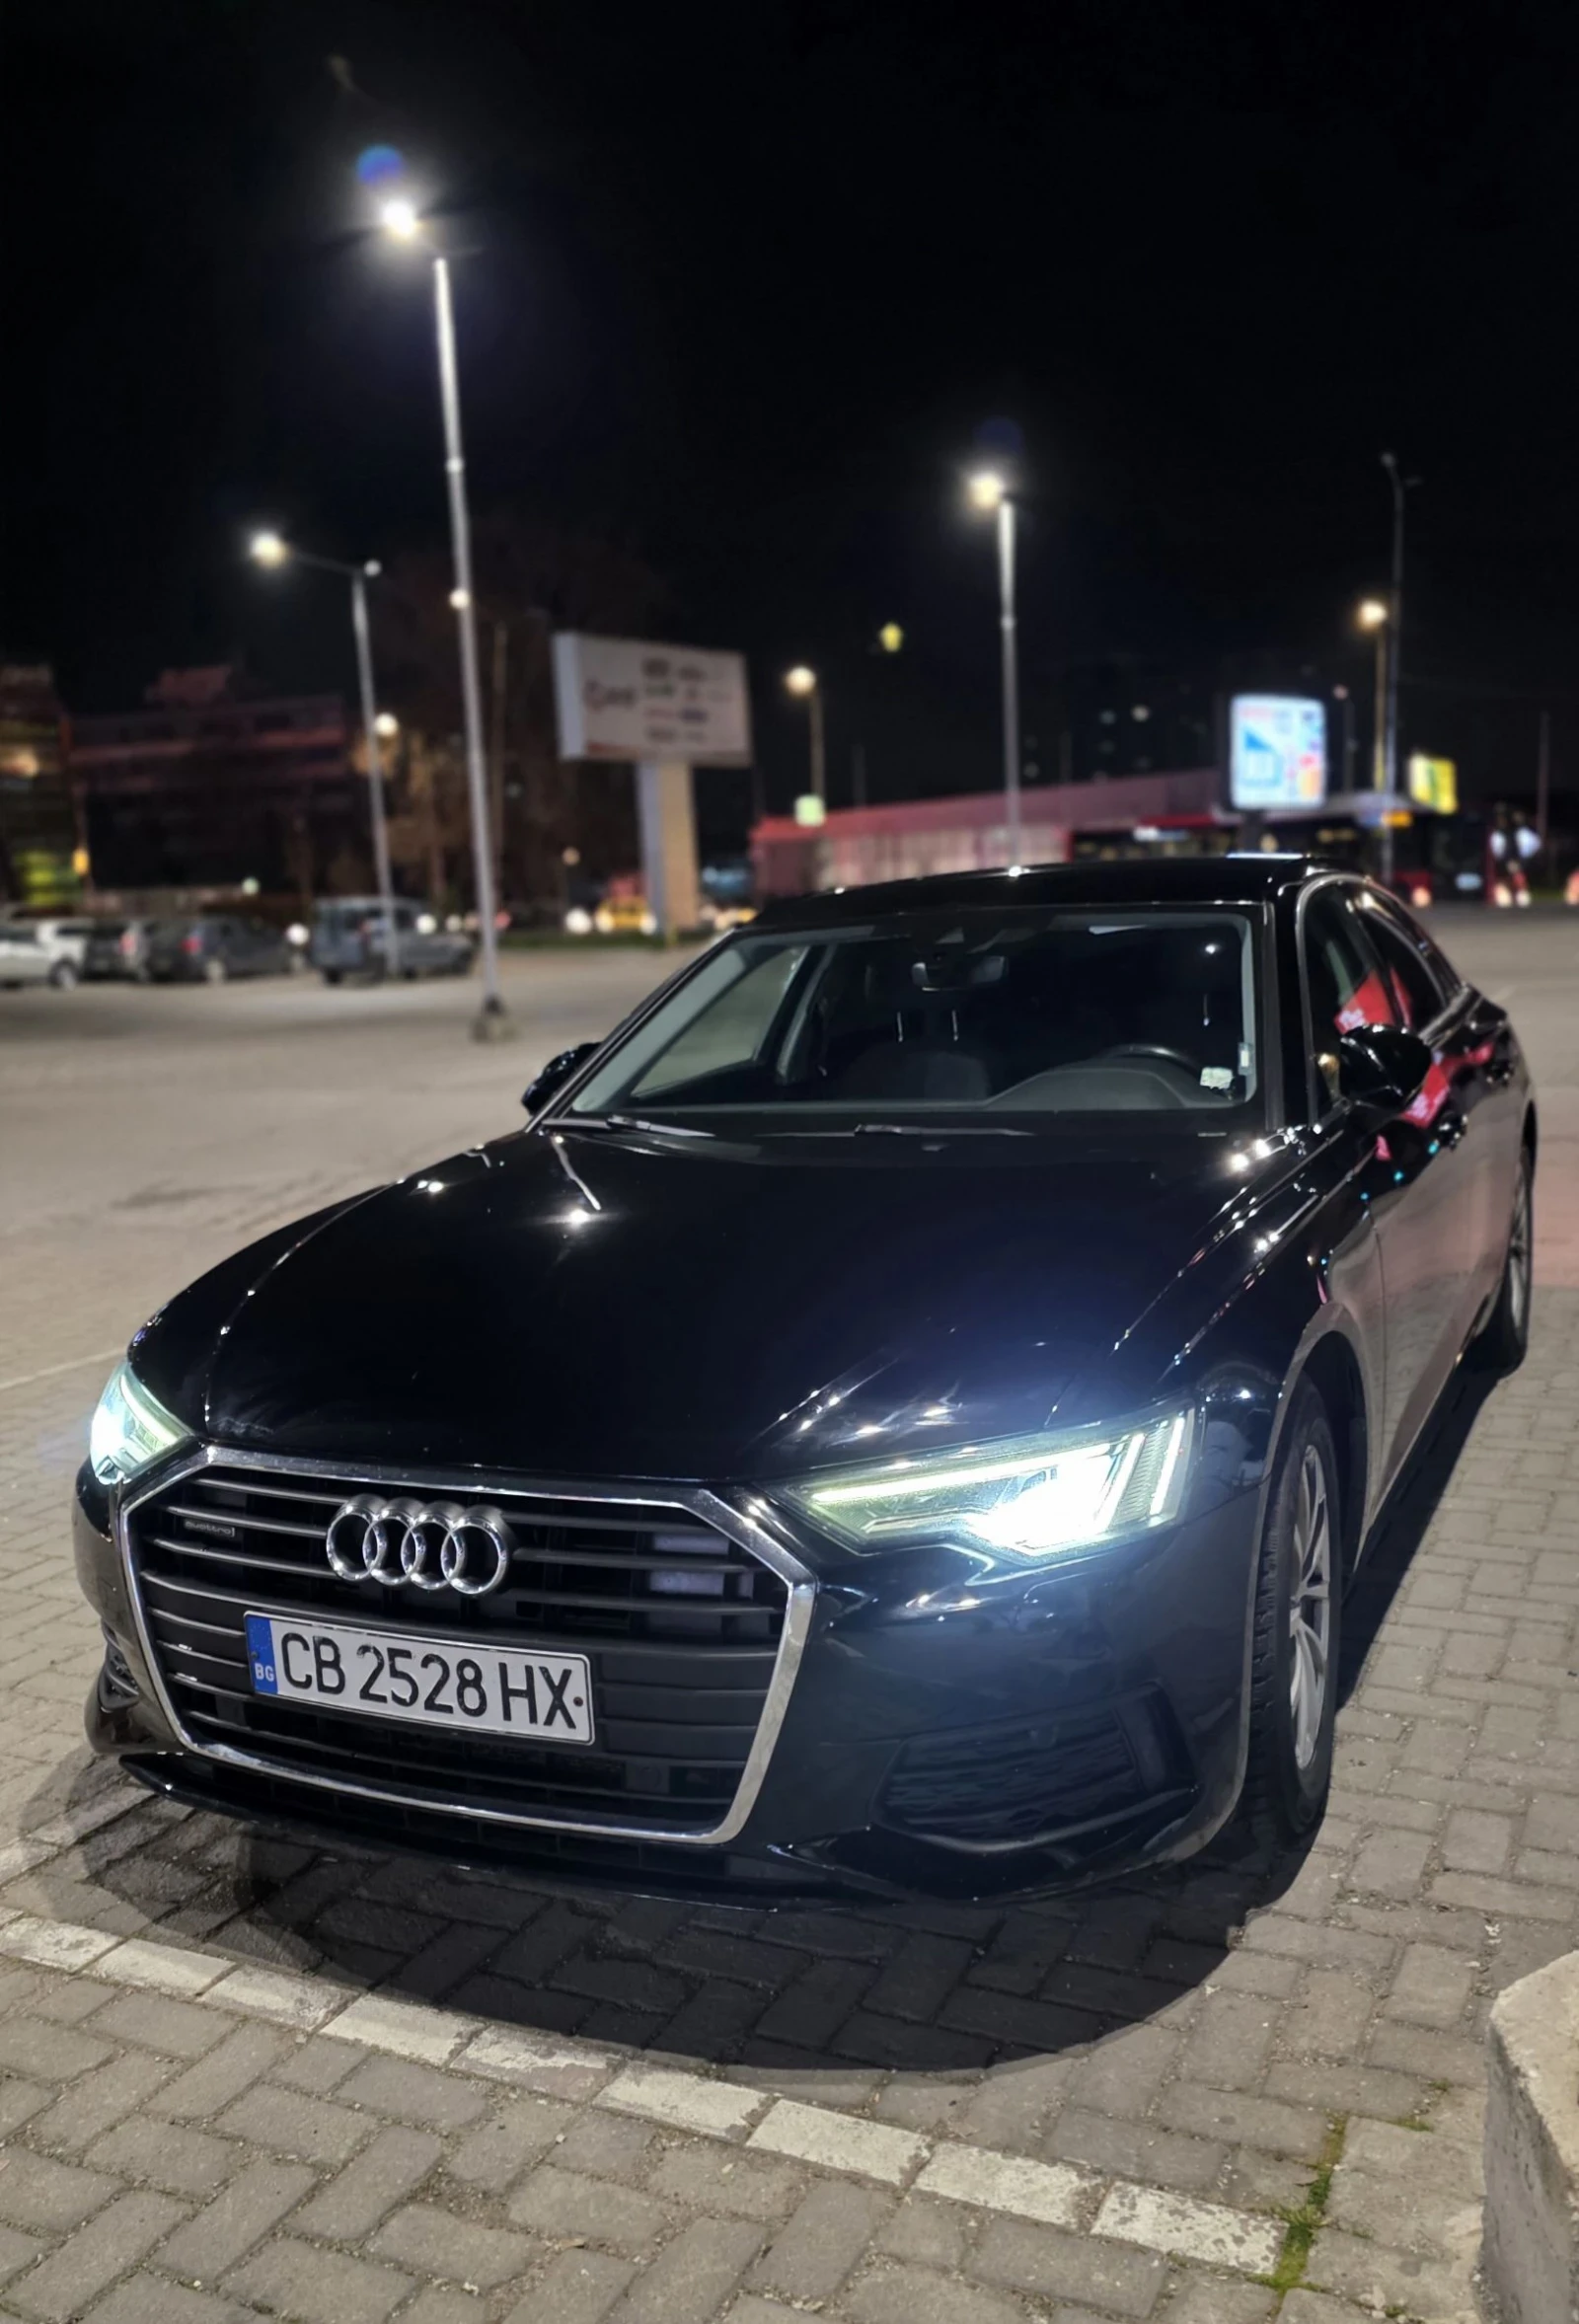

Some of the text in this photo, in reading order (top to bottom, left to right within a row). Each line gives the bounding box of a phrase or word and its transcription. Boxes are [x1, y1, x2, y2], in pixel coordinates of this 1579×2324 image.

[255, 1663, 274, 1682] BG
[281, 1632, 577, 1730] CB 2528 HX
